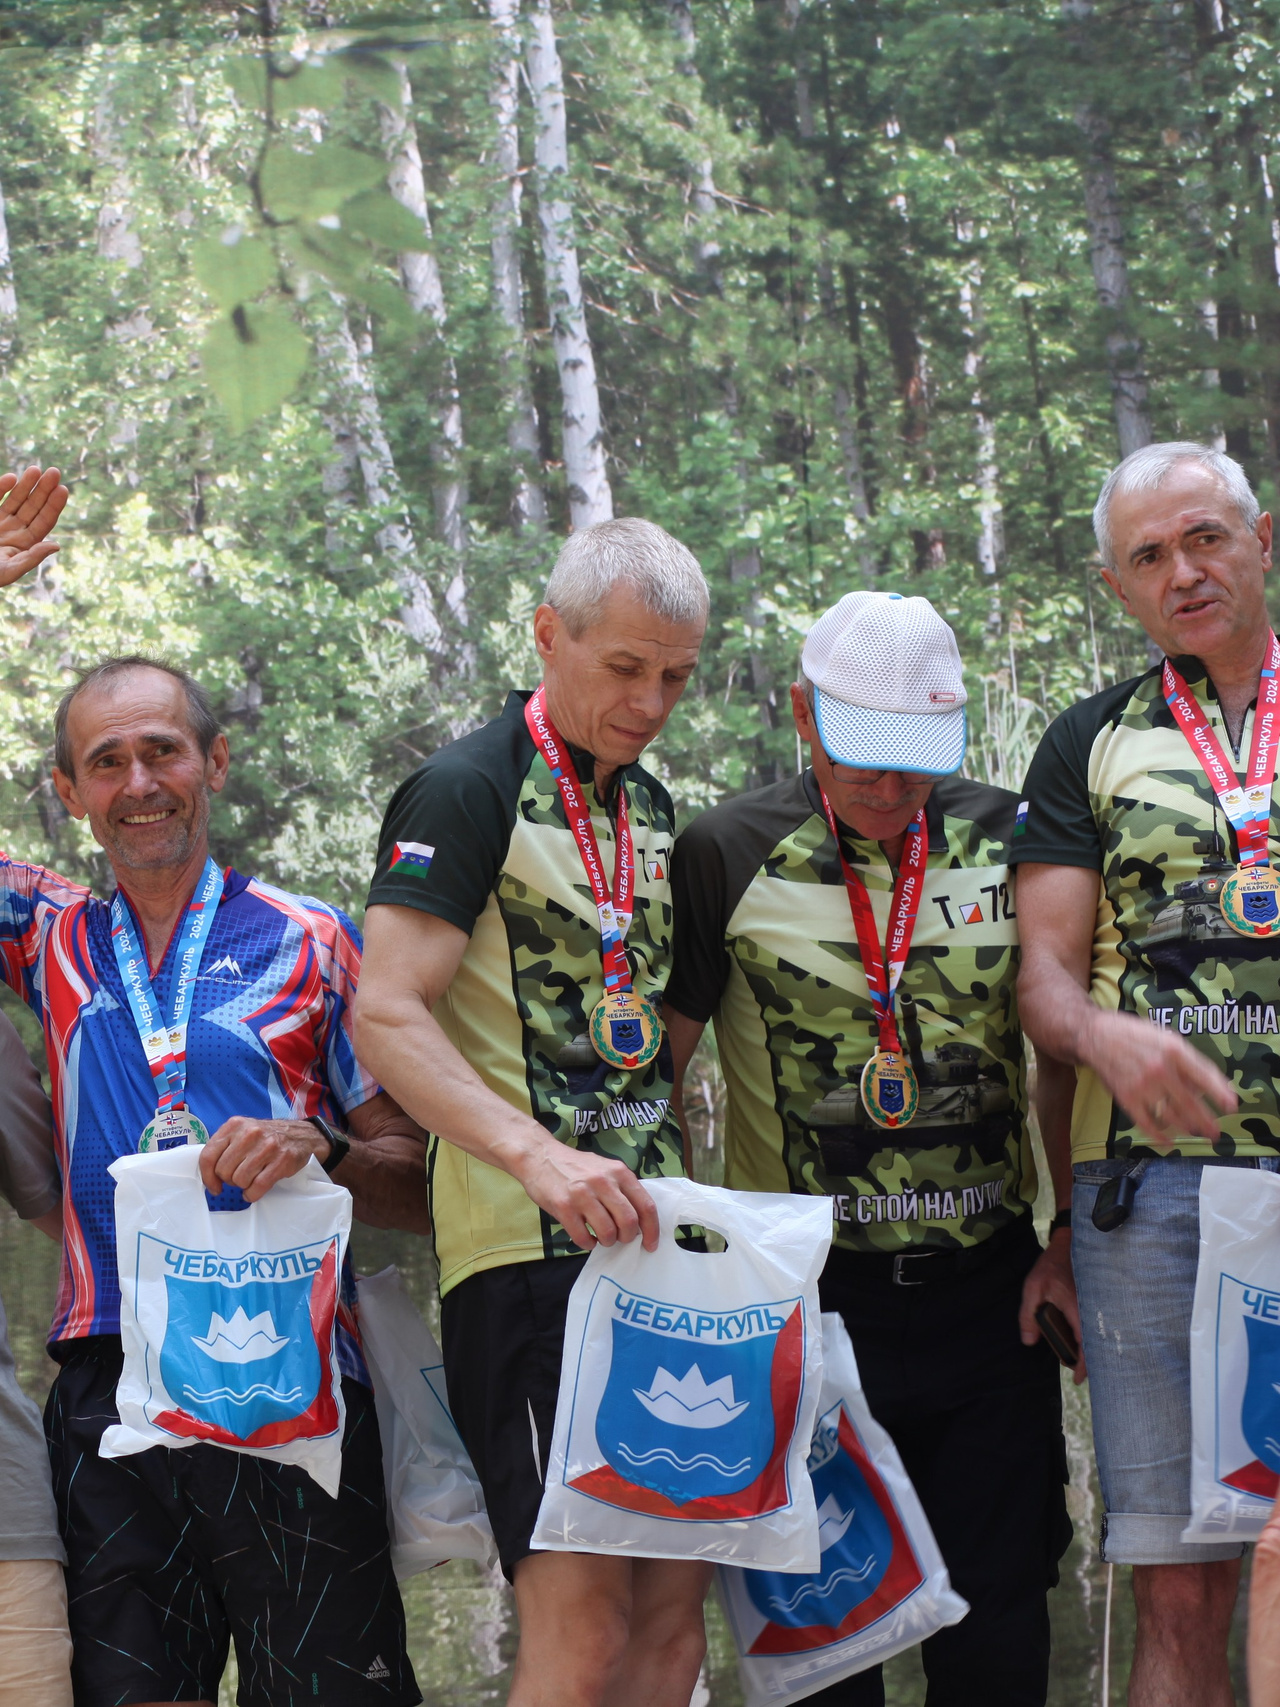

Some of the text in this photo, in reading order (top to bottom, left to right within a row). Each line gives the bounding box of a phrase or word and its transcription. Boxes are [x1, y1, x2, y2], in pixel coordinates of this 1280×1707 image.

[1176, 696, 1195, 722] 2024
[1255, 712, 1274, 778] ЧЕБАРКУЛЬ
[1266, 679, 1278, 703] 2024
[1193, 726, 1228, 787] ЧЕБАРКУЛЬ
[531, 698, 604, 898] ЧЕБАРКУЛЬ 2024 ЧЕБАРКУЛЬ
[620, 829, 629, 902] ЧЕБАРКУЛЬ
[891, 877, 915, 952] ЧЕБАРКУЛЬ
[909, 835, 922, 867] 2024
[980, 882, 1017, 922] 72
[120, 928, 132, 953] 2024
[173, 947, 195, 1020] ЧЕБАРКУЛЬ
[190, 913, 205, 939] 2024
[127, 959, 153, 1027] ЧЕБАРКУЛЬ
[1179, 999, 1238, 1034] СТОЙ
[1245, 1004, 1279, 1034] НА
[155, 1128, 191, 1138] ЧЕБАРКУЛЬ
[629, 1101, 660, 1126] НА
[856, 1188, 918, 1223] СТОЙ
[924, 1191, 957, 1220] НА
[962, 1178, 1005, 1217] ПУТИ!
[165, 1248, 322, 1283] ЧЕБАРКУЛЬ
[614, 1292, 786, 1340] ЧЕБАРКУЛЬ
[296, 1487, 304, 1509] adidas
[366, 1669, 390, 1679] adidas
